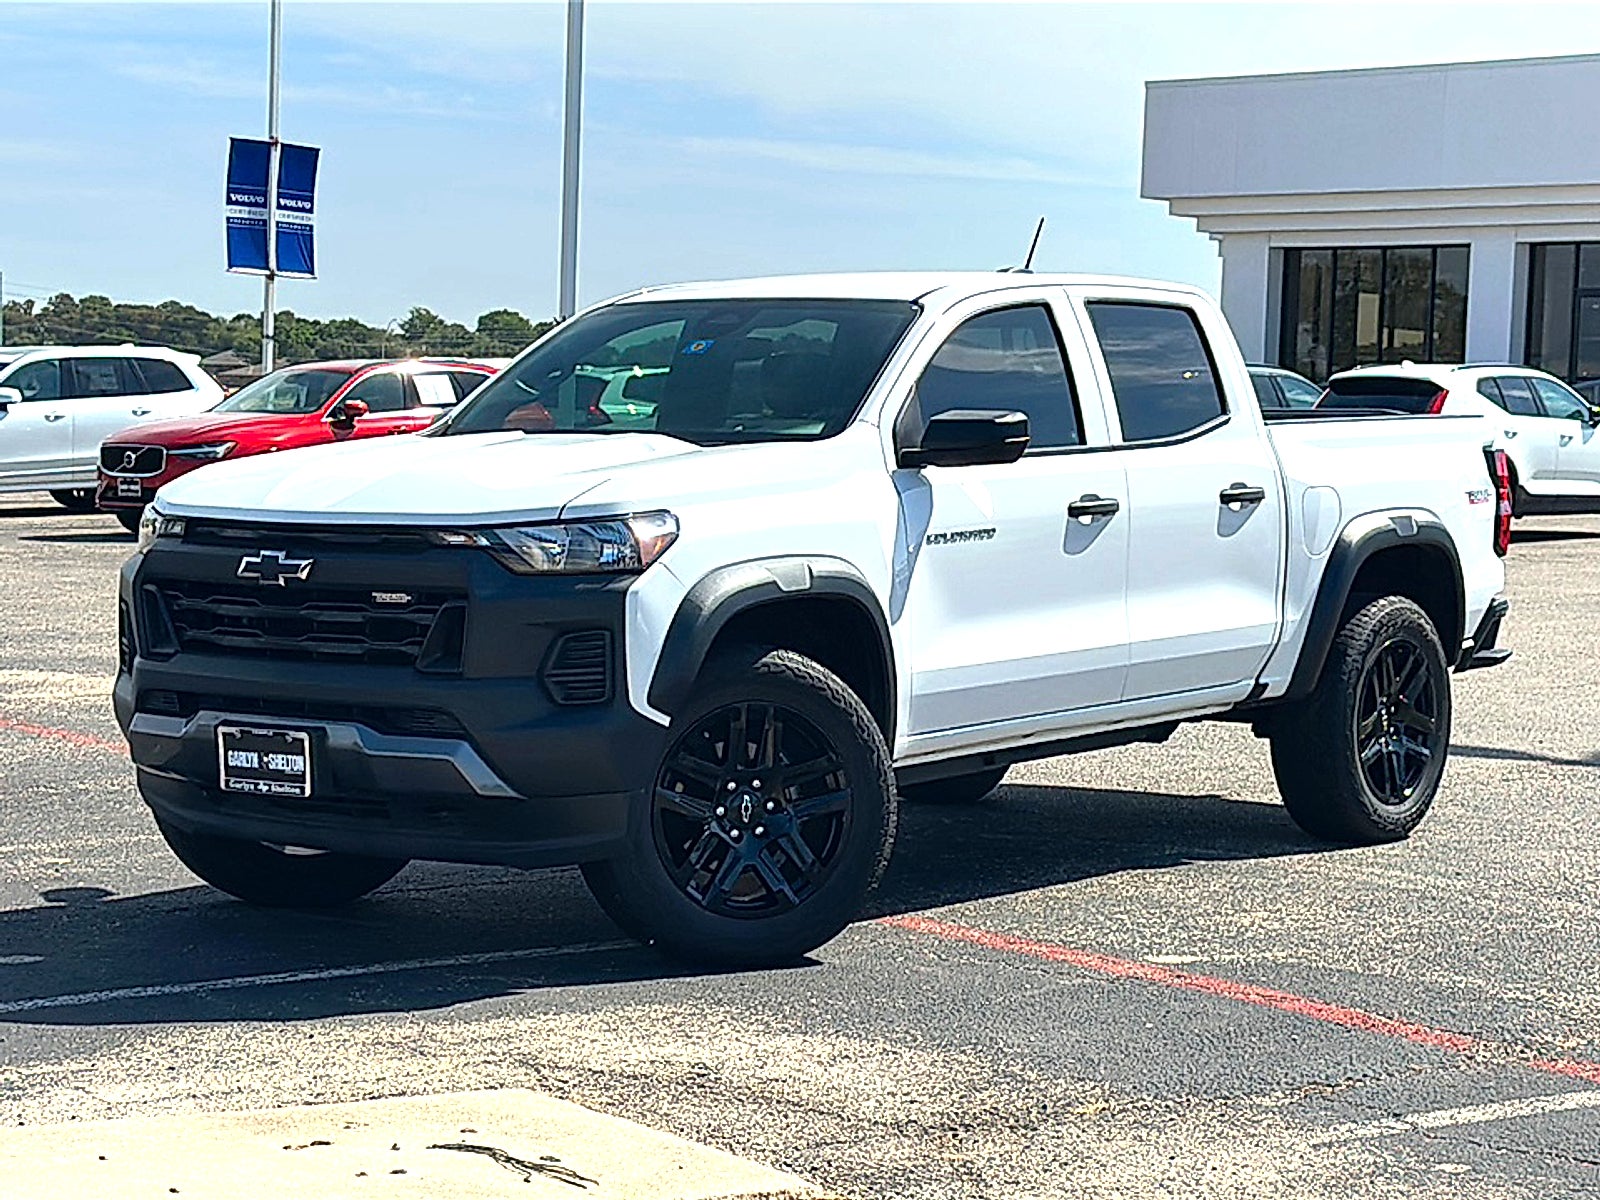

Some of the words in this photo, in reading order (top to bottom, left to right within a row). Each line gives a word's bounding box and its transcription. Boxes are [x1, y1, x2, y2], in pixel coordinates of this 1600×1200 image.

[229, 193, 265, 203] VOLVO
[279, 198, 311, 209] VOLVO
[268, 753, 304, 771] SHELTON
